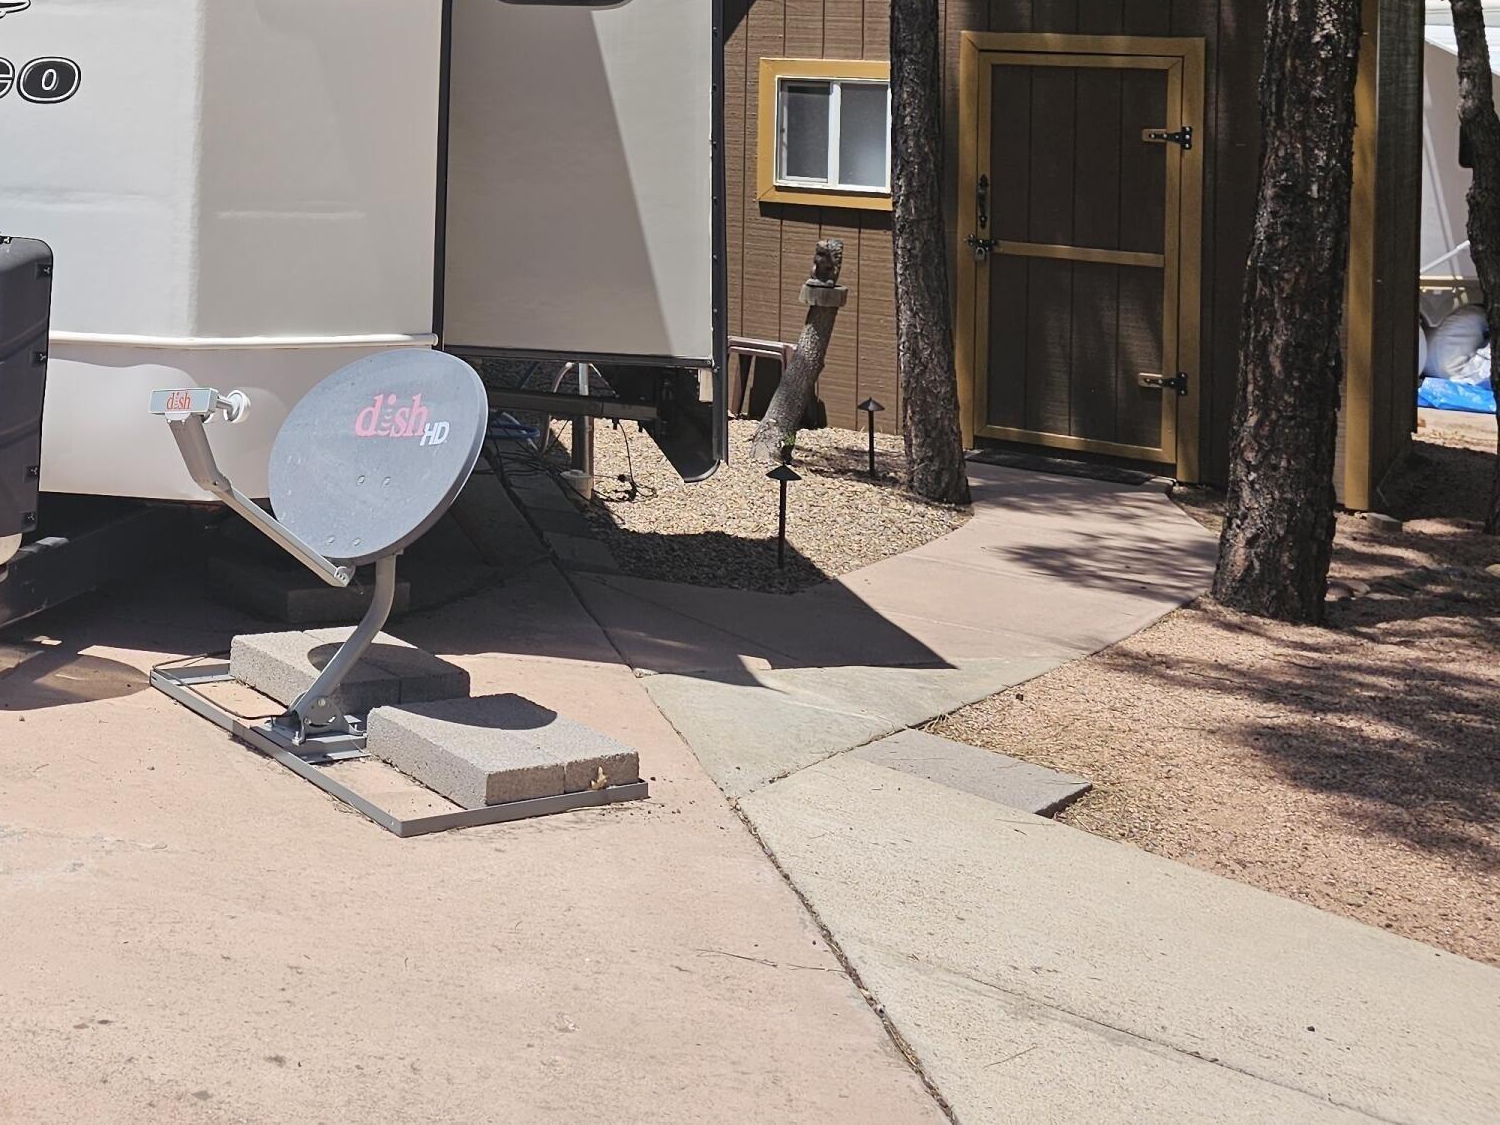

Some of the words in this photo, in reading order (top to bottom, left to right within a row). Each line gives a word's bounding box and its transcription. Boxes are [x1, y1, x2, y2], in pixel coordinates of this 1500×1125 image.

[166, 391, 191, 410] dish
[355, 393, 429, 437] dish
[419, 421, 450, 446] HD
